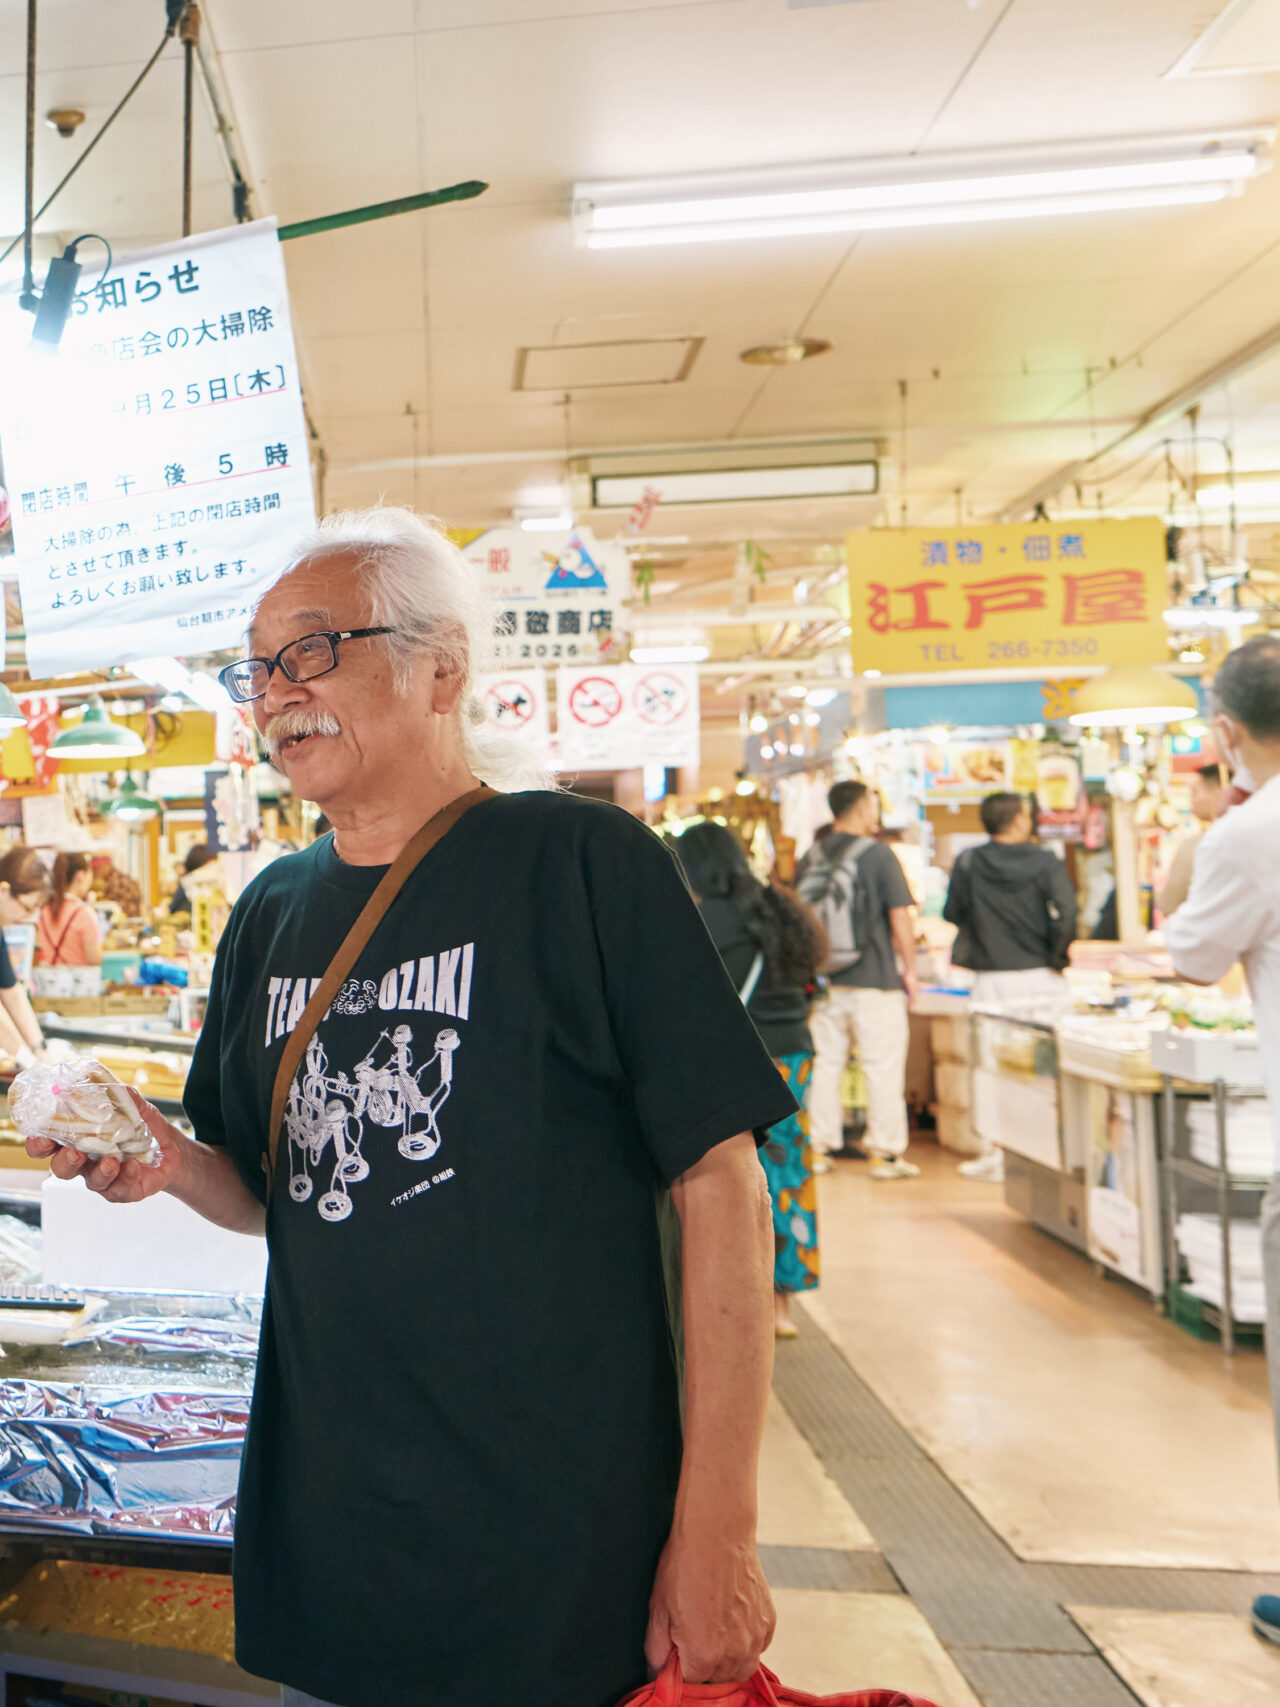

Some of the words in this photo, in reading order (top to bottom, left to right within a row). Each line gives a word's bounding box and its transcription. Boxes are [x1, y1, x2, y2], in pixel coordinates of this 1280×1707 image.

[47, 539, 198, 580] とさせて頂きます。
[50, 558, 257, 610] よろしくお願い致します。
[866, 568, 1149, 634] 江戸屋
[920, 642, 964, 662] TEL
[986, 637, 1099, 660] 266-7350
[377, 942, 475, 1021] OZAKI
